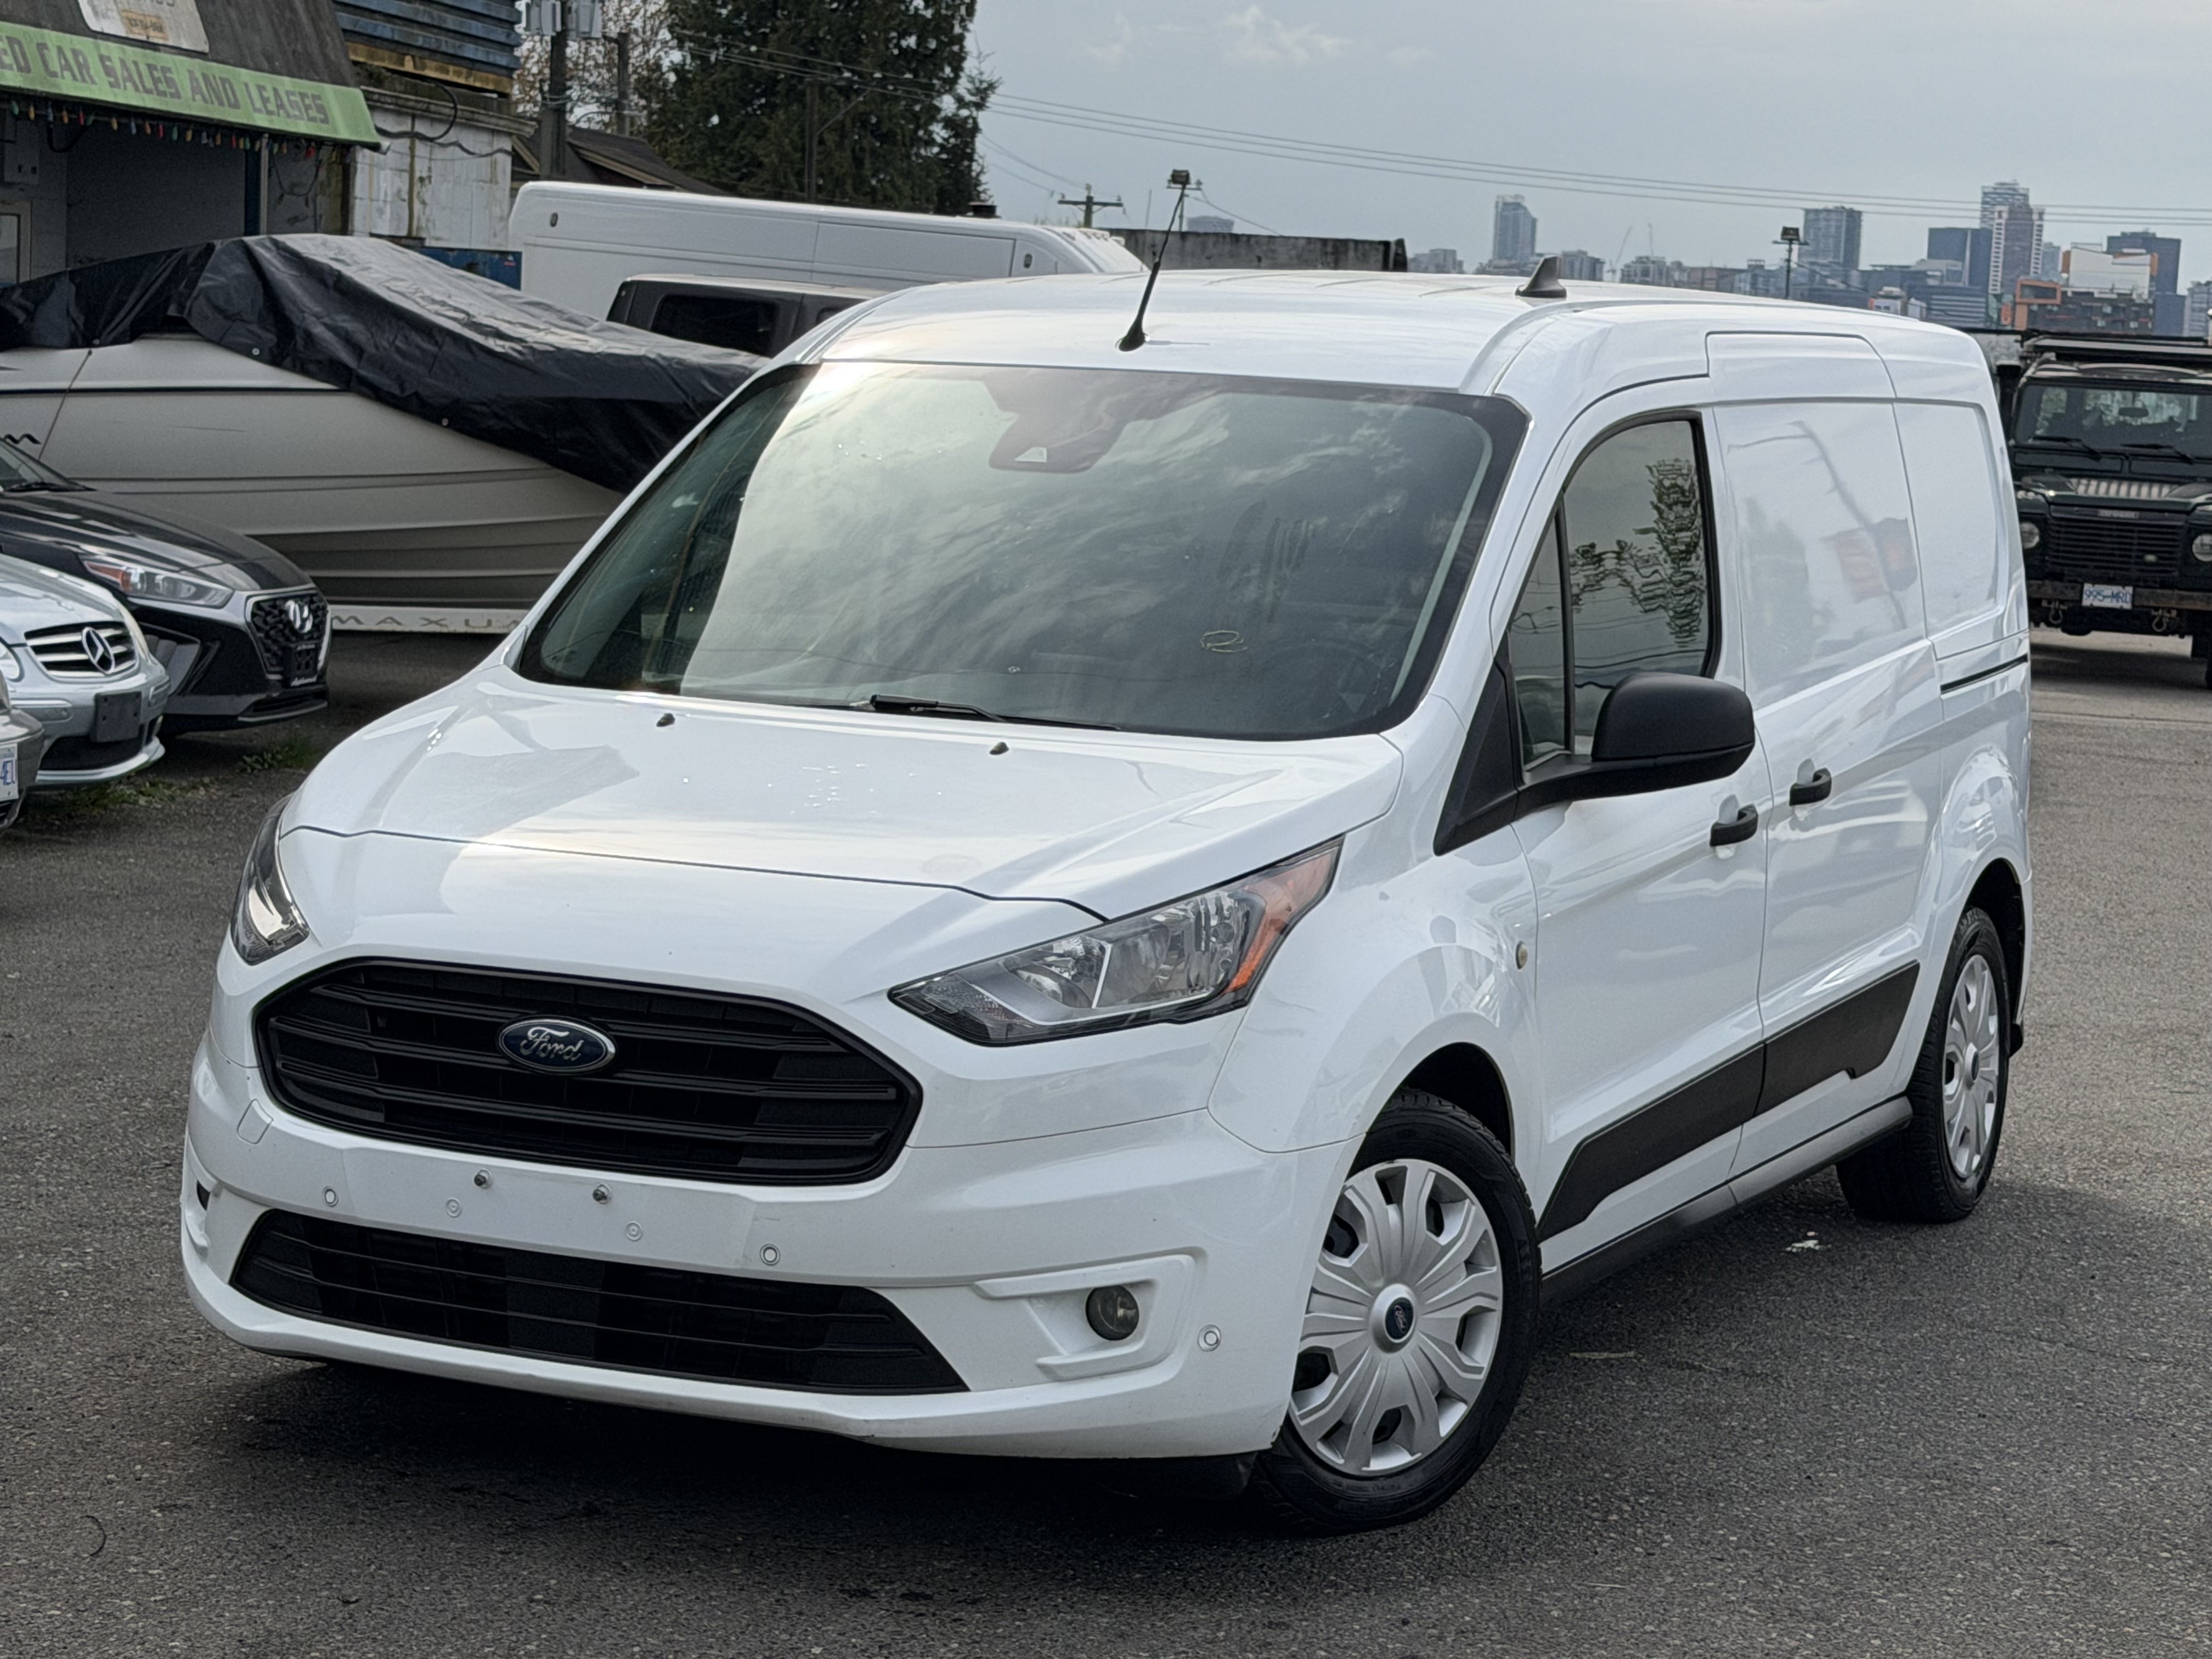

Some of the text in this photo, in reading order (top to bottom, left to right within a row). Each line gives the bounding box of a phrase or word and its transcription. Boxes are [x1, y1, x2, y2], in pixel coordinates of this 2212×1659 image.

[36, 42, 97, 85] CAR
[99, 53, 182, 100] SALES
[187, 69, 241, 110] AND
[244, 82, 329, 125] LEASES
[520, 1026, 585, 1062] Ford
